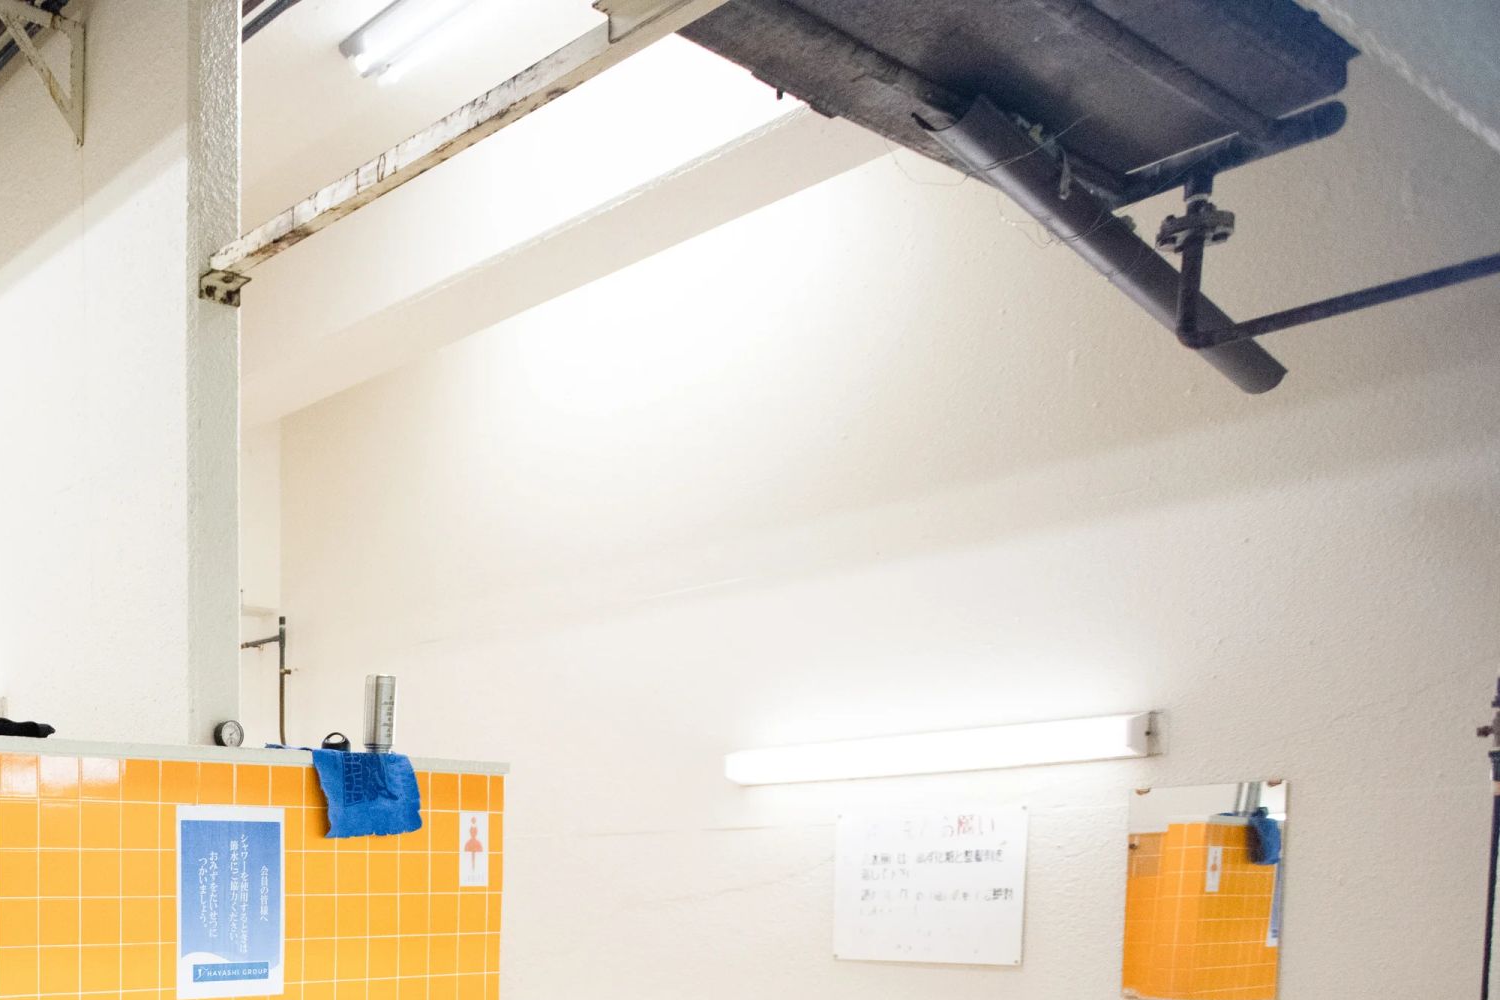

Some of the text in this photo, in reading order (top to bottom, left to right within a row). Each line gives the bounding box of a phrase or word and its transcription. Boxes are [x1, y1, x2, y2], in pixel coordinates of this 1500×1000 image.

[198, 858, 208, 928] つかいましょう。
[209, 851, 219, 938] おみずをたいせつに
[239, 834, 249, 953] シャワーを使用するときは
[260, 865, 269, 922] 会員の皆様へ
[207, 967, 268, 977] HAYASHI GROUP
